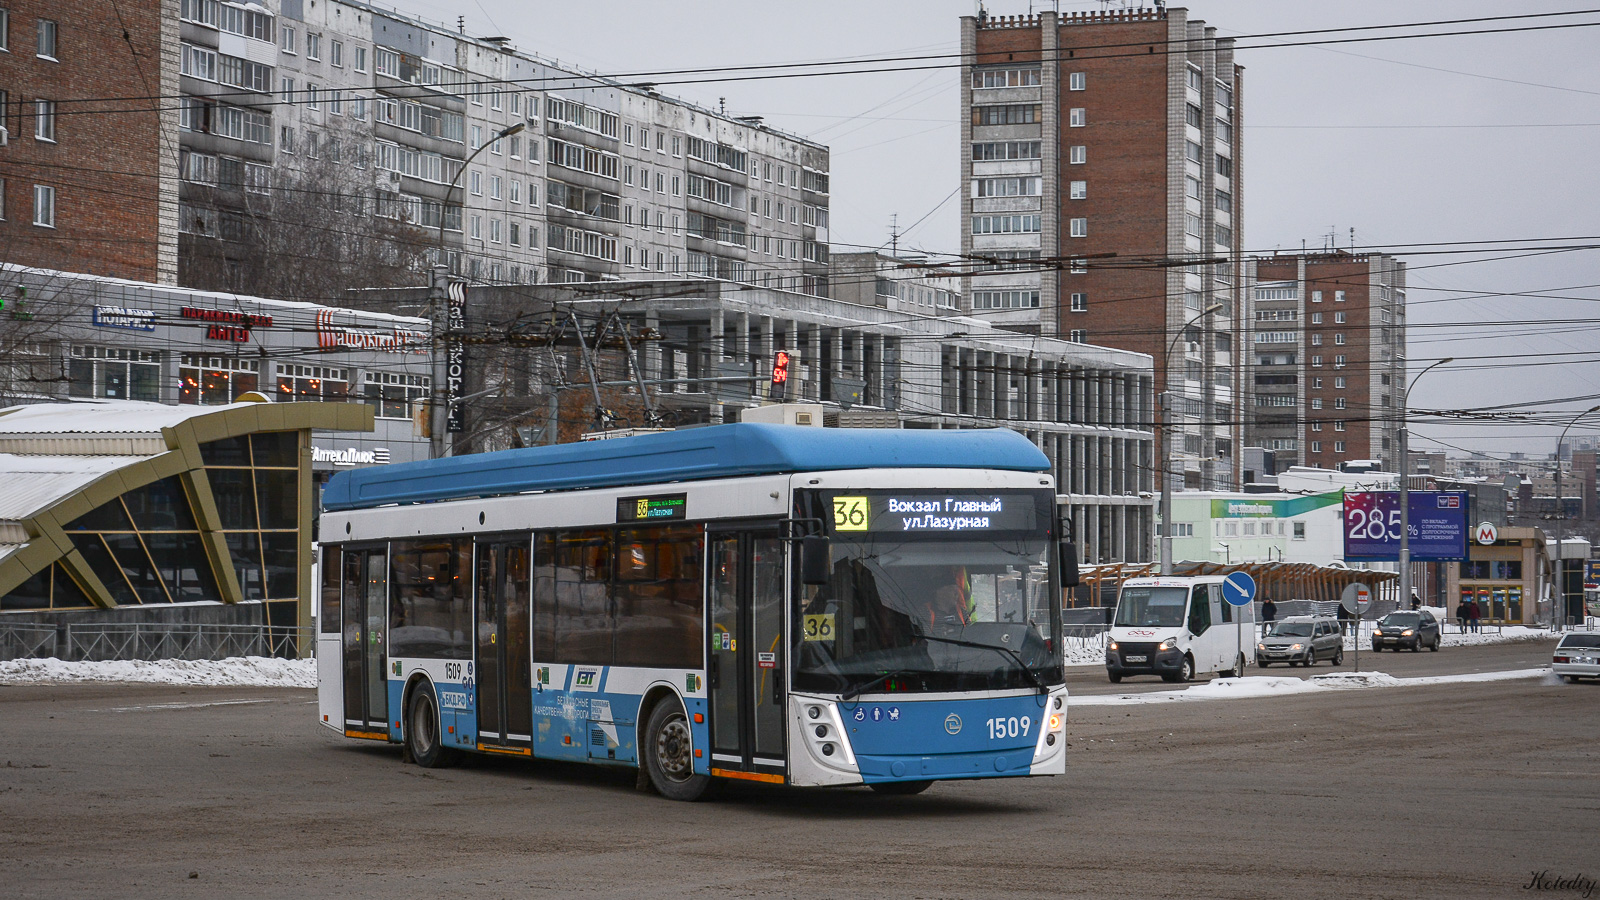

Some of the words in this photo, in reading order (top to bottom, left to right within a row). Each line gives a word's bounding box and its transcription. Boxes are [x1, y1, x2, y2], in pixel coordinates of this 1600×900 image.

[182, 305, 273, 328] ПАРИКМАХЕСКАЯ
[208, 324, 250, 343] АНГЕЛ
[637, 501, 648, 517] 36
[833, 501, 865, 527] 36
[889, 498, 941, 513] Вокзал
[945, 497, 1002, 513] Главный
[902, 515, 989, 530] ул.Лазурная
[807, 618, 832, 637] 36
[445, 662, 461, 680] 1509
[986, 716, 1031, 740] 1509
